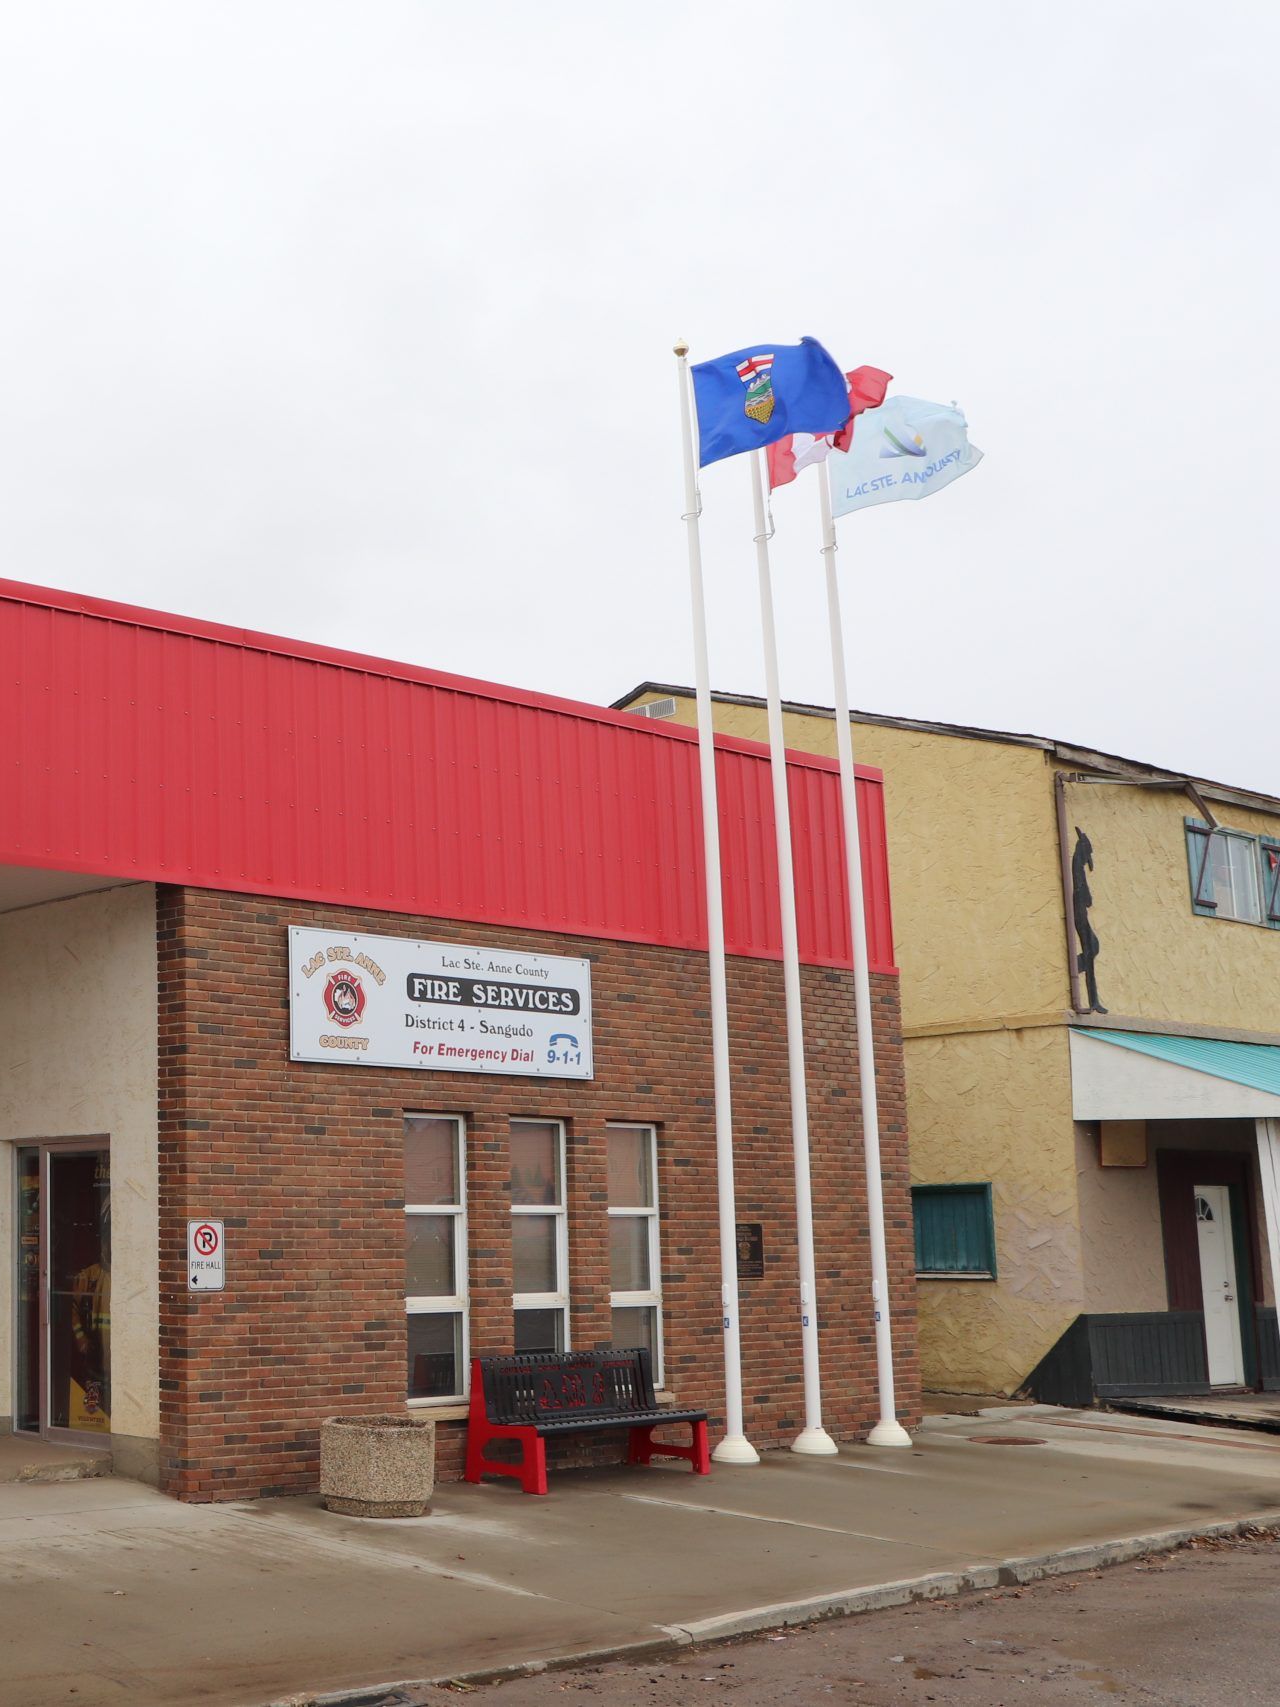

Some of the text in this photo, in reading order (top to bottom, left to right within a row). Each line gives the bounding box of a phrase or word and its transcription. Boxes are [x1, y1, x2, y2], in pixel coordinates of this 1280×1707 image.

[846, 483, 869, 499] LAC
[871, 474, 897, 491] STE.
[301, 946, 387, 986] LAC STE. ANNE
[337, 974, 352, 982] FIRE
[441, 956, 549, 980] Lac Ste. Anne County
[412, 978, 574, 1012] FIRE SERVICES
[404, 1014, 454, 1032] District
[457, 1019, 465, 1032] 4
[479, 1020, 533, 1038] Sangudo
[319, 1035, 369, 1050] COUNTY
[413, 1041, 582, 1065] For Emergency Dial 9-1-1
[191, 1261, 221, 1269] FIRE HALL
